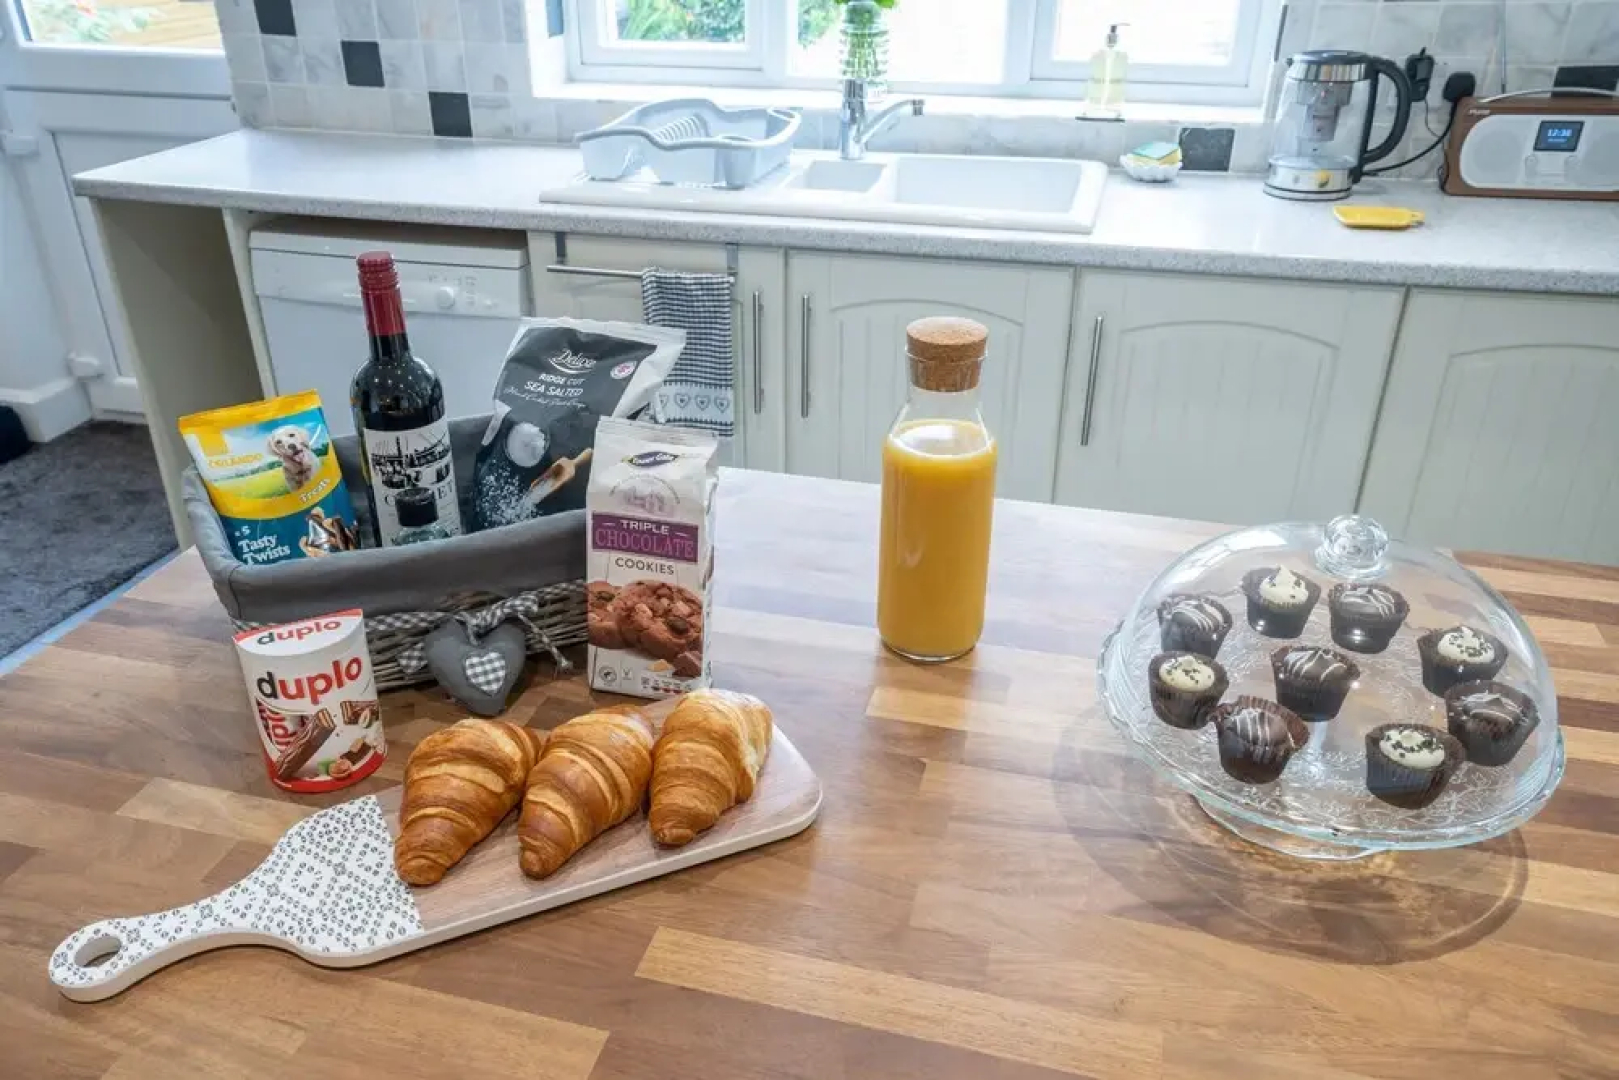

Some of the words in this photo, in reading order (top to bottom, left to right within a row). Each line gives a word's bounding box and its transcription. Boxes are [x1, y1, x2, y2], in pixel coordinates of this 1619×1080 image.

[524, 380, 545, 392] SEA
[546, 386, 584, 397] SALTED
[538, 373, 566, 385] RIDGE
[567, 378, 585, 386] CUT
[619, 519, 670, 535] TRIPLE
[238, 533, 278, 552] Tasty
[595, 528, 694, 558] CHOCOLATE
[243, 544, 291, 566] Twists
[614, 556, 675, 576] COOKIES
[256, 620, 342, 645] duplo
[256, 656, 362, 706] duplo
